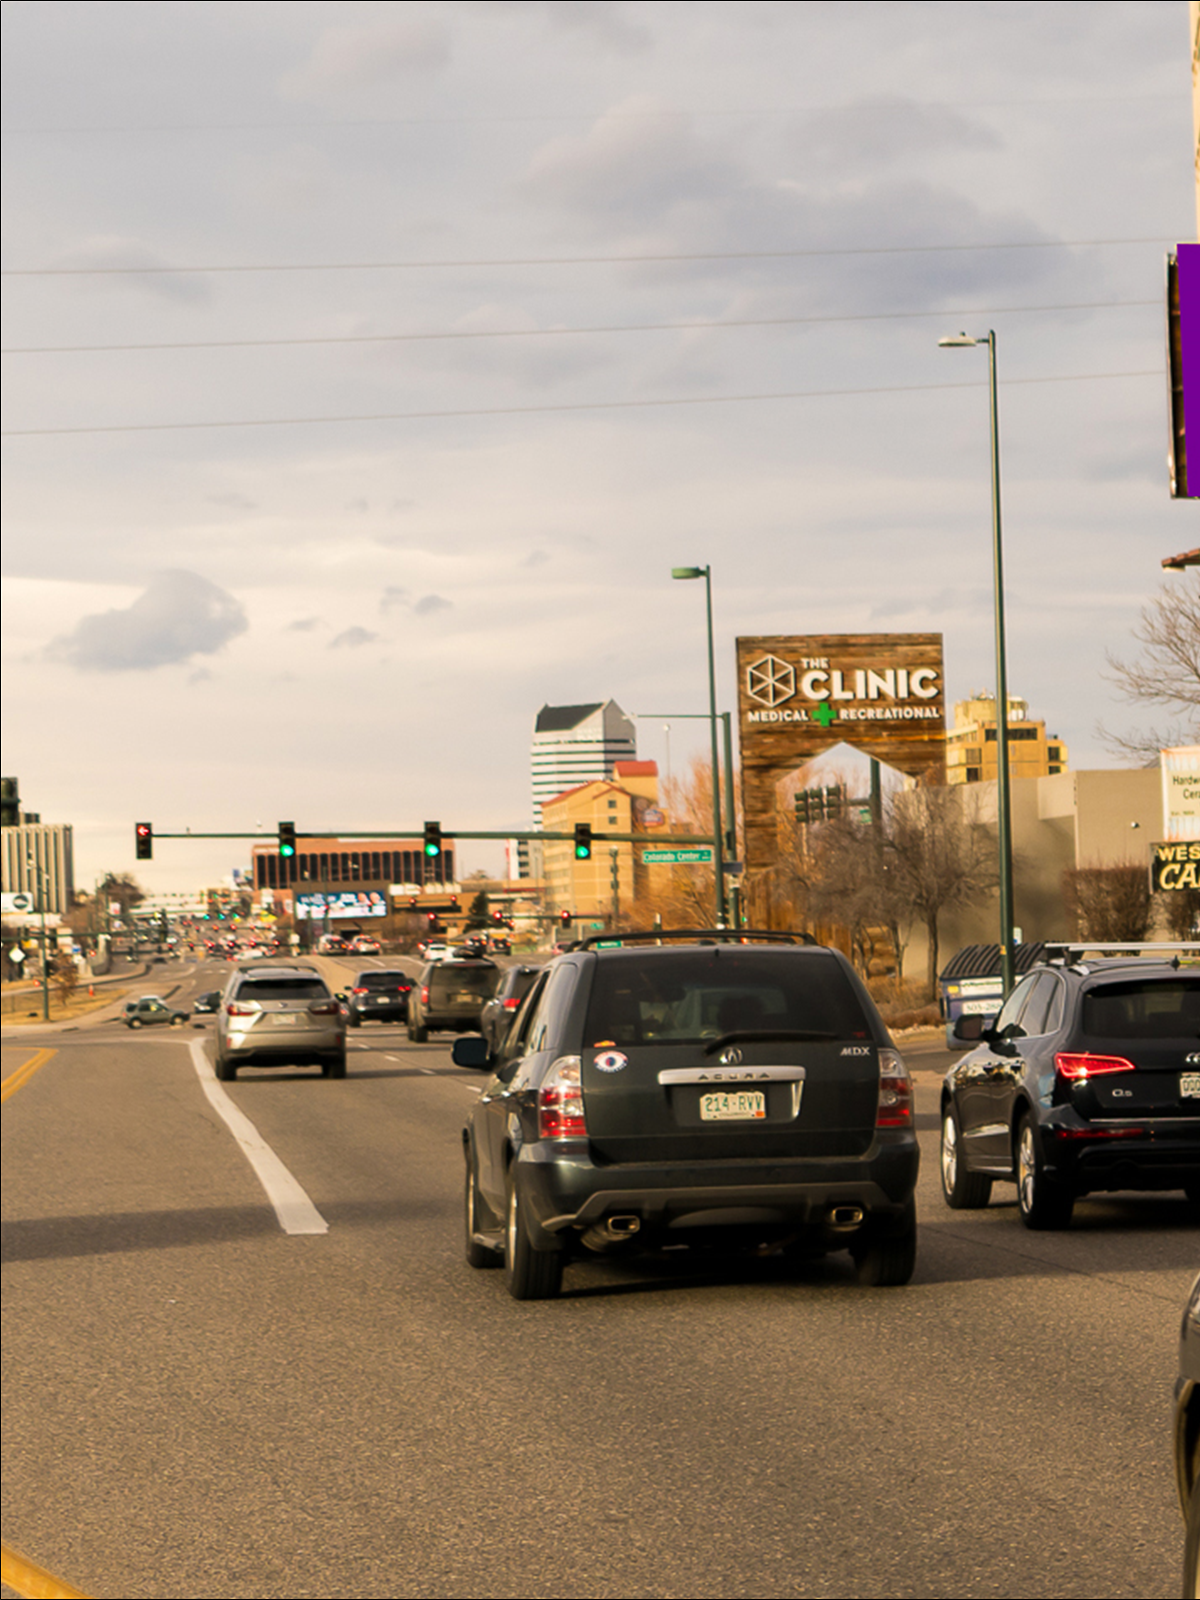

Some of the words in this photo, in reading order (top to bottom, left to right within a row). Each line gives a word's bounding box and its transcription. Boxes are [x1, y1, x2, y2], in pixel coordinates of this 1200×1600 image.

[801, 657, 829, 669] THE
[801, 668, 939, 700] CLINIC
[748, 709, 809, 722] MEDICAL
[839, 706, 940, 720] RECREATIONAL
[840, 1047, 870, 1056] MDX
[698, 1072, 770, 1080] ACURA
